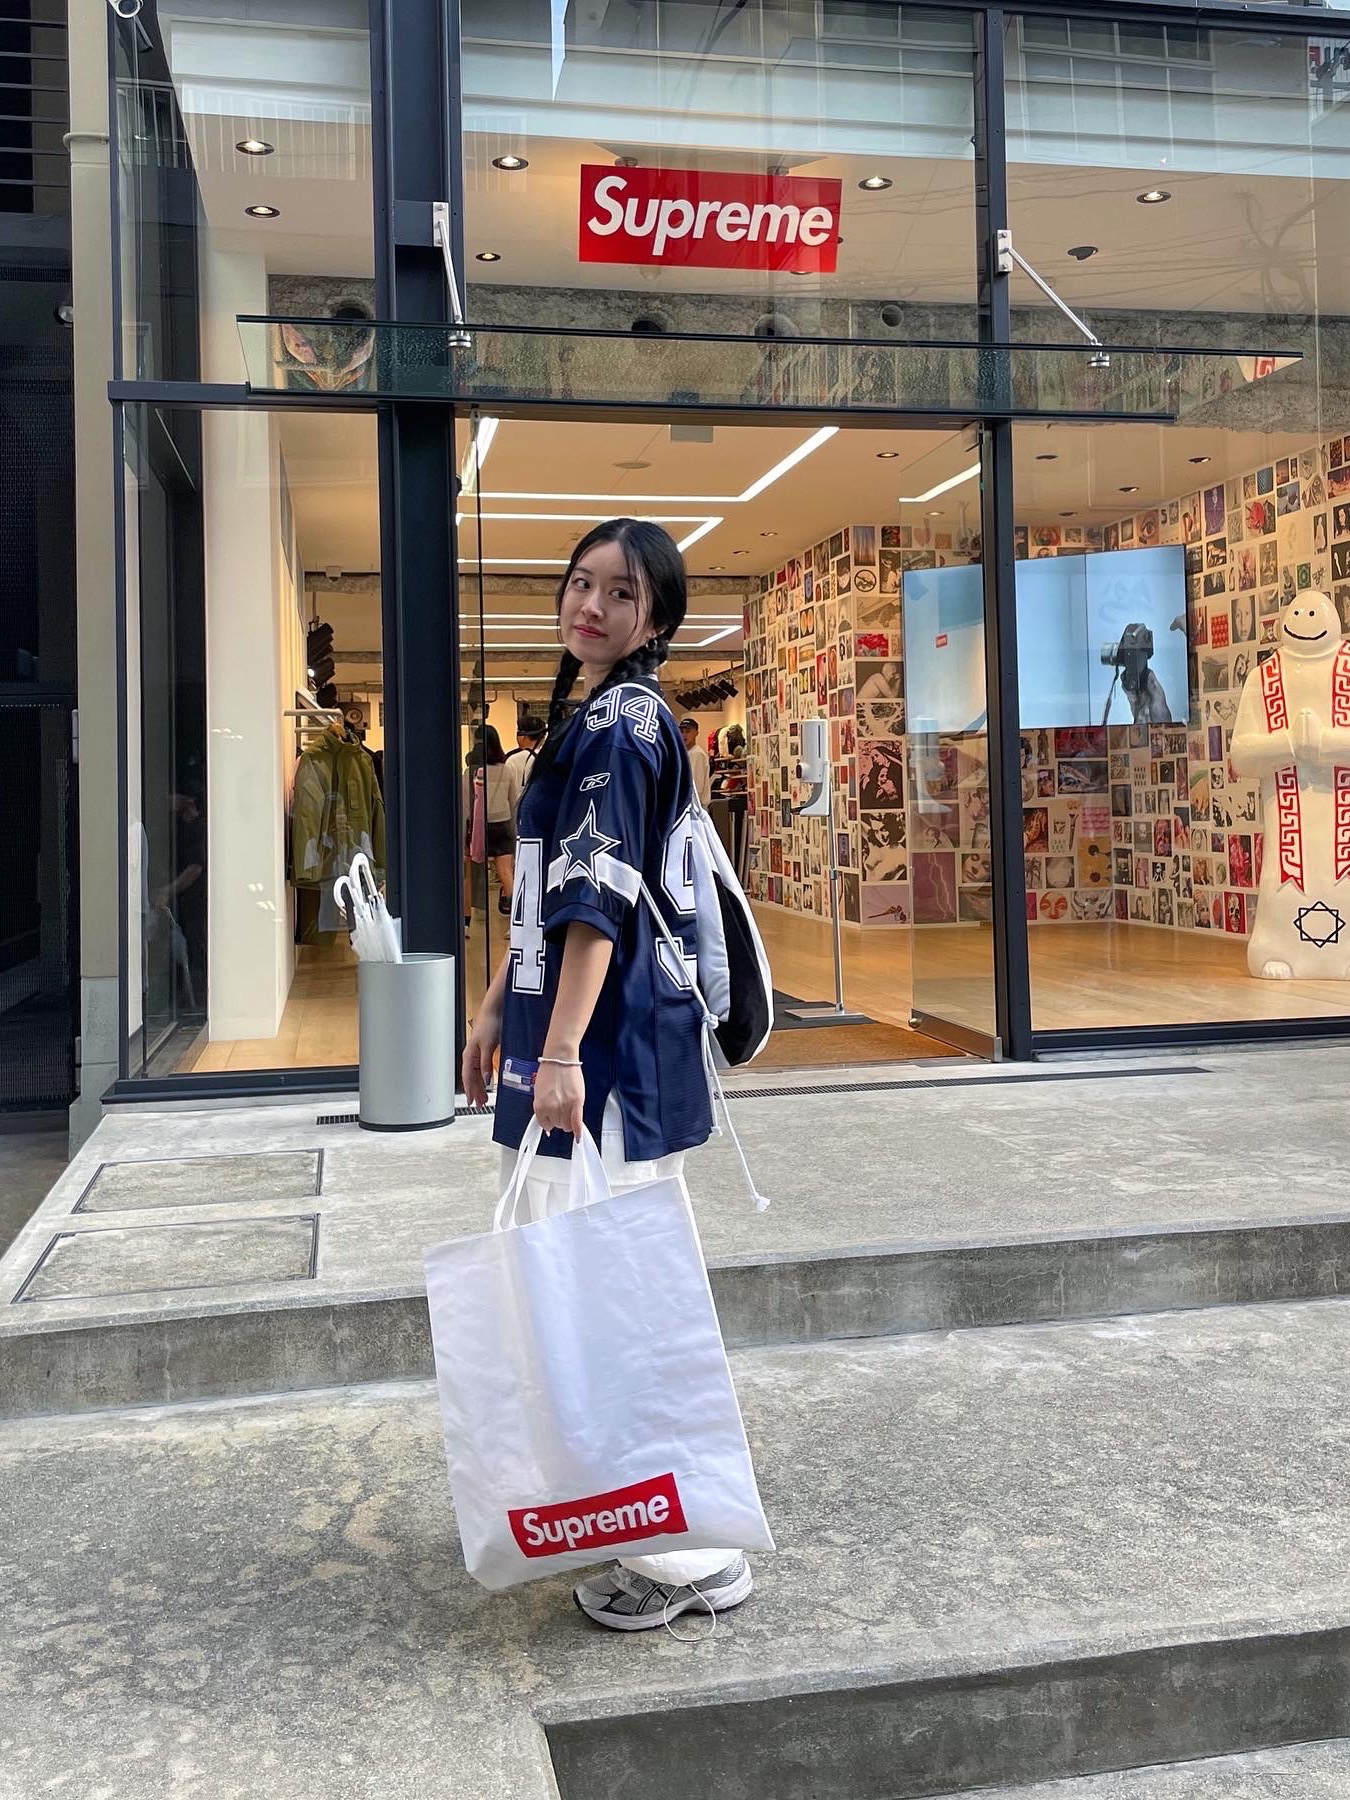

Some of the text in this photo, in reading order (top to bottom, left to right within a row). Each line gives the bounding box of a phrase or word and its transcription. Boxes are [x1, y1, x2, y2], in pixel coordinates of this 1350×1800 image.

[587, 175, 833, 256] Supreme
[586, 687, 660, 744] 94
[522, 1495, 669, 1548] Supreme
